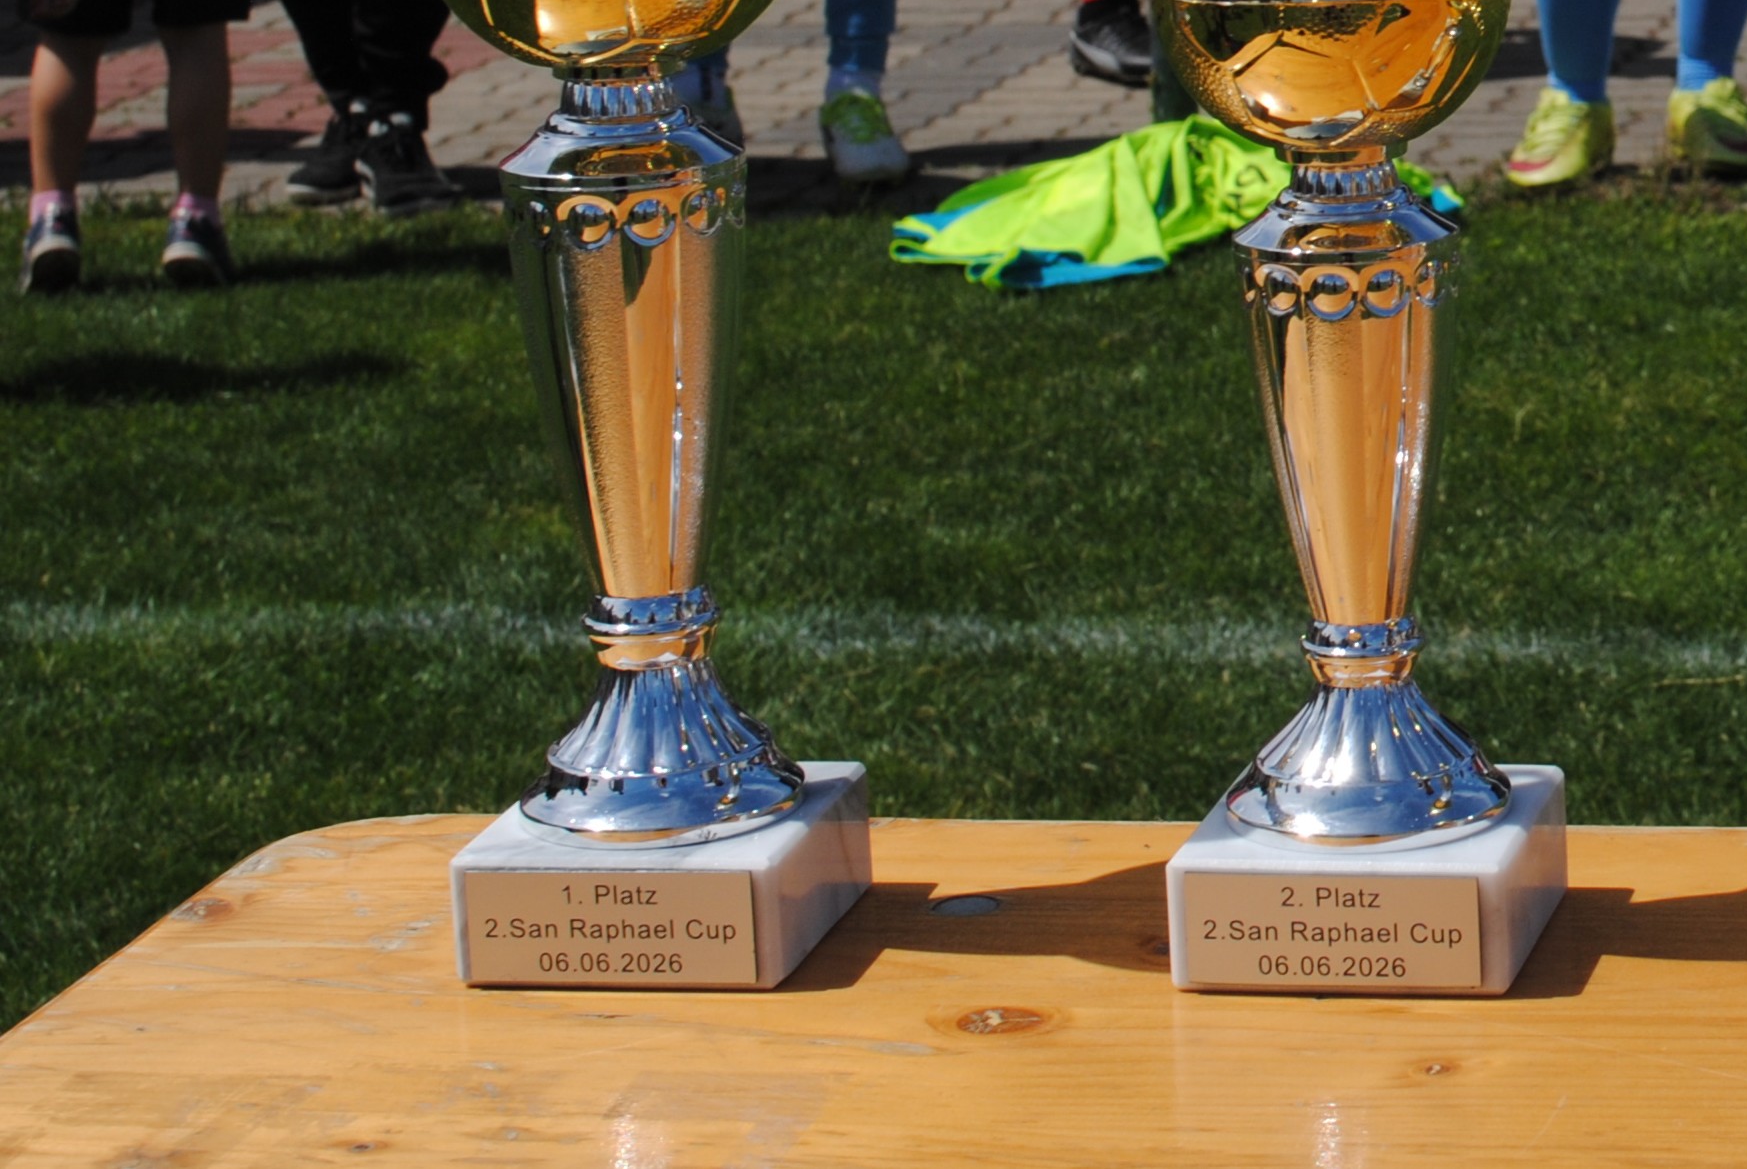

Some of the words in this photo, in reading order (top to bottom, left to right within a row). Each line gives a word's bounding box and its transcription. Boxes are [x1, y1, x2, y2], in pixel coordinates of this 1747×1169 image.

[561, 884, 584, 905] 1.
[594, 884, 659, 906] Platz
[1280, 886, 1304, 908] 2.
[1315, 886, 1381, 909] Platz
[484, 917, 559, 940] 2.San
[569, 918, 676, 945] Raphael
[685, 918, 738, 946] Cup
[1203, 919, 1280, 942] 2.San
[1290, 920, 1399, 948] Raphael
[1409, 922, 1463, 950] Cup
[539, 951, 684, 974] 06.06.2026
[1258, 954, 1408, 979] 06.06.2026
